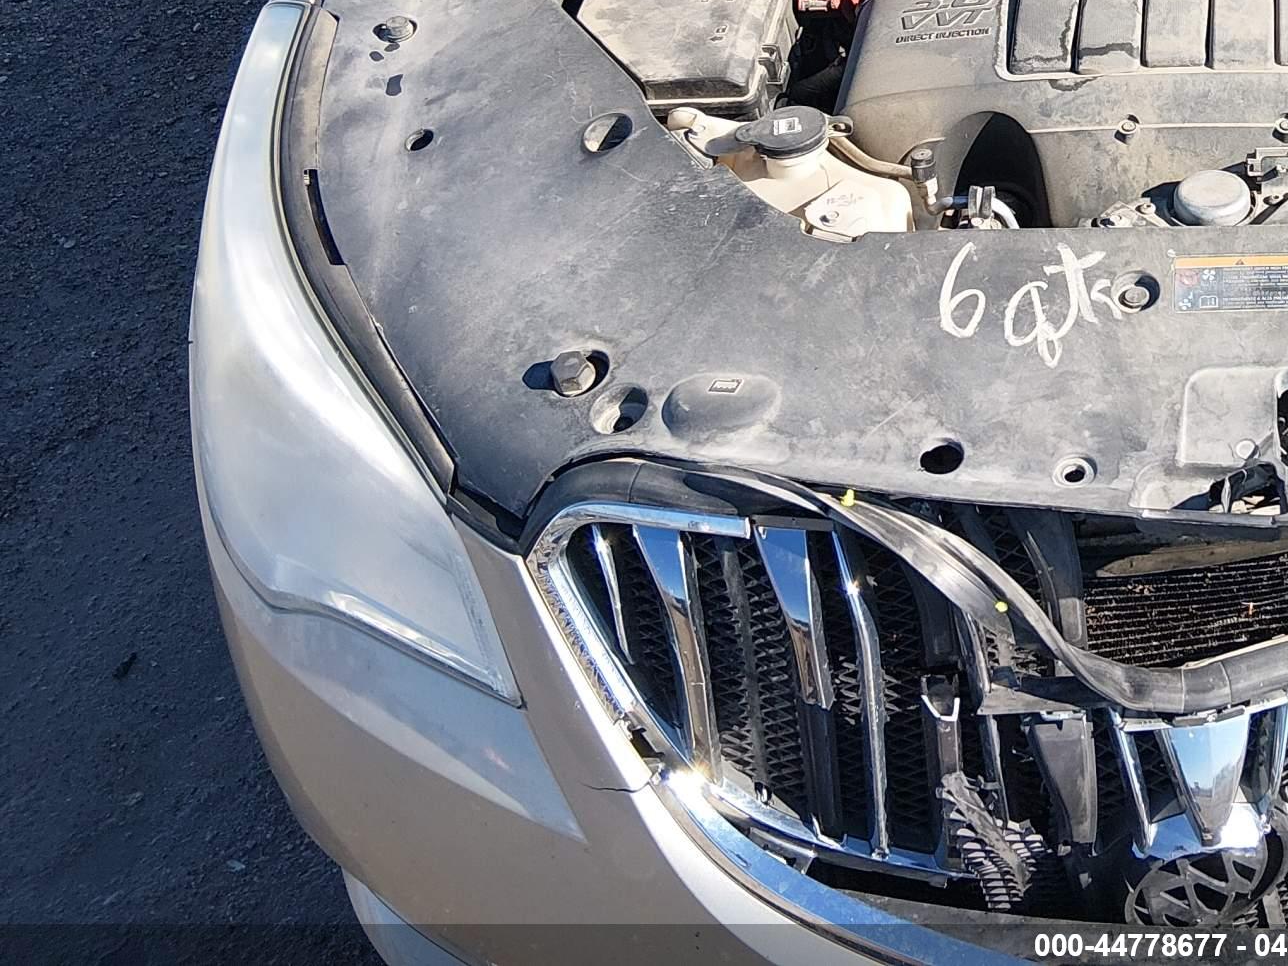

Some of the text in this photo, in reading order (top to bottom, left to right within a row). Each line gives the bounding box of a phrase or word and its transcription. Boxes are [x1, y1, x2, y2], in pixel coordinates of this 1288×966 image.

[901, 7, 993, 30] VVT
[896, 28, 991, 44] DIRECT INJECTION
[939, 241, 987, 339] 6
